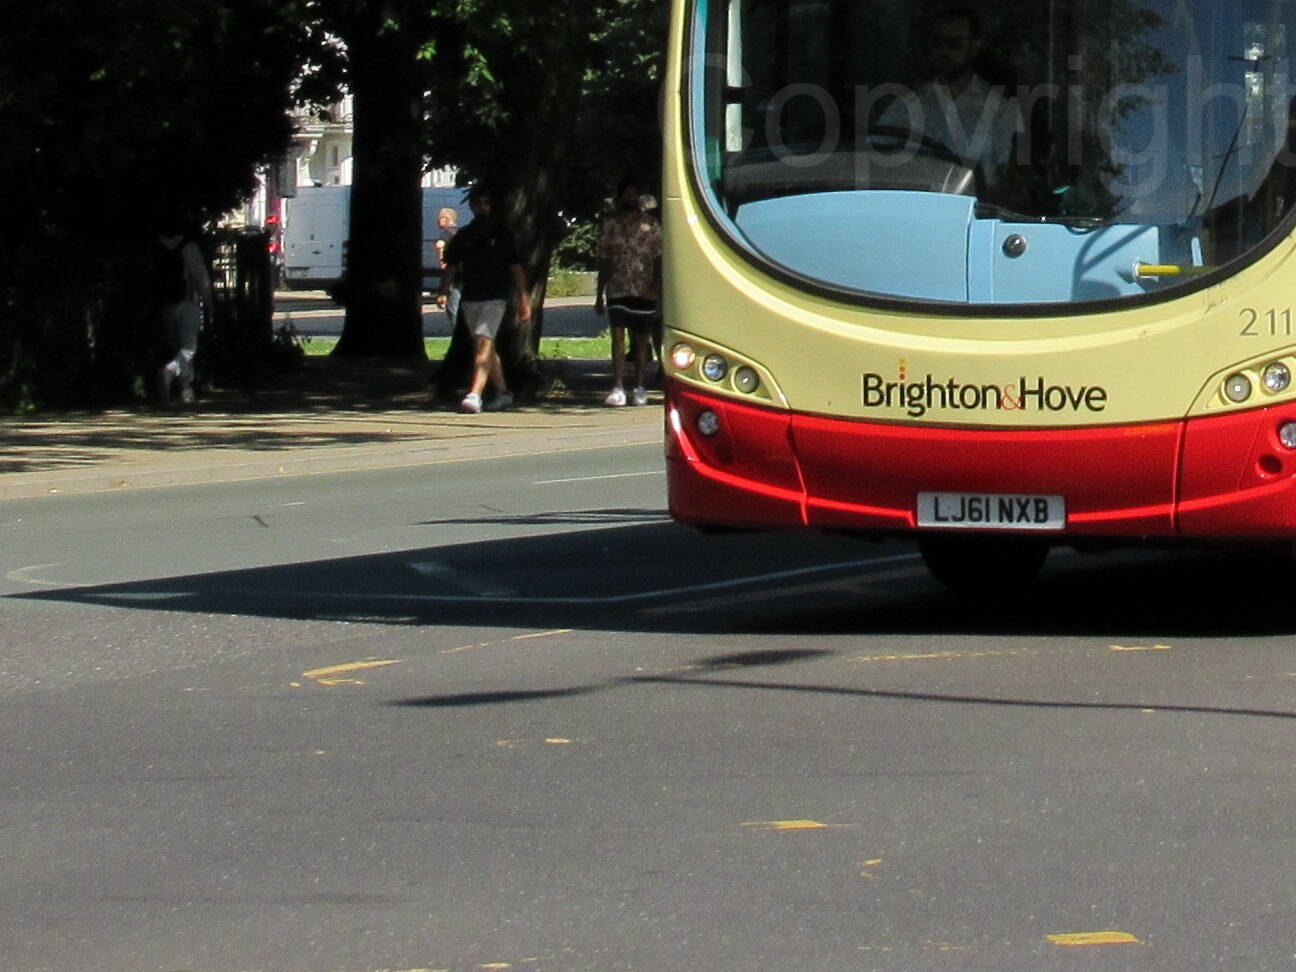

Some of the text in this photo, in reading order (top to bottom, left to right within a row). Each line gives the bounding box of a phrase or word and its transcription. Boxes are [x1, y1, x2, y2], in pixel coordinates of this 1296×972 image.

[1239, 307, 1291, 336] 211
[862, 368, 1108, 417] Brighton&Hove
[933, 496, 1049, 524] LJ61 NXB
